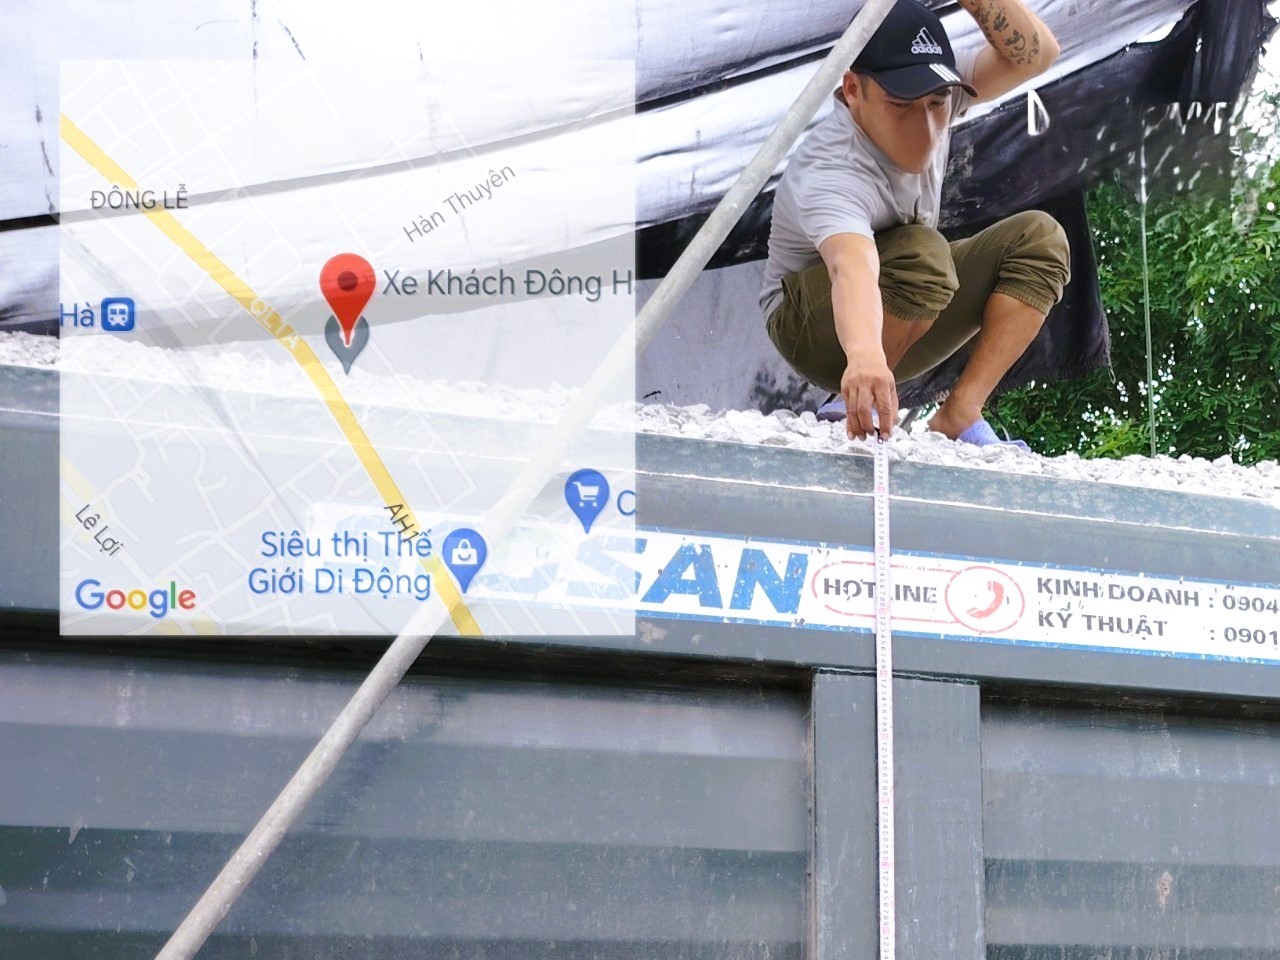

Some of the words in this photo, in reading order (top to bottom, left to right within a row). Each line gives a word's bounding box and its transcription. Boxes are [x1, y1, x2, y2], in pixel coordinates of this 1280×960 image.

[911, 45, 943, 55] adidas
[823, 577, 938, 604] HOTINE
[1037, 577, 1099, 599] KINH
[1108, 584, 1200, 607] DOANH
[1038, 602, 1073, 629] KỸ
[1081, 614, 1168, 641] THUẬT
